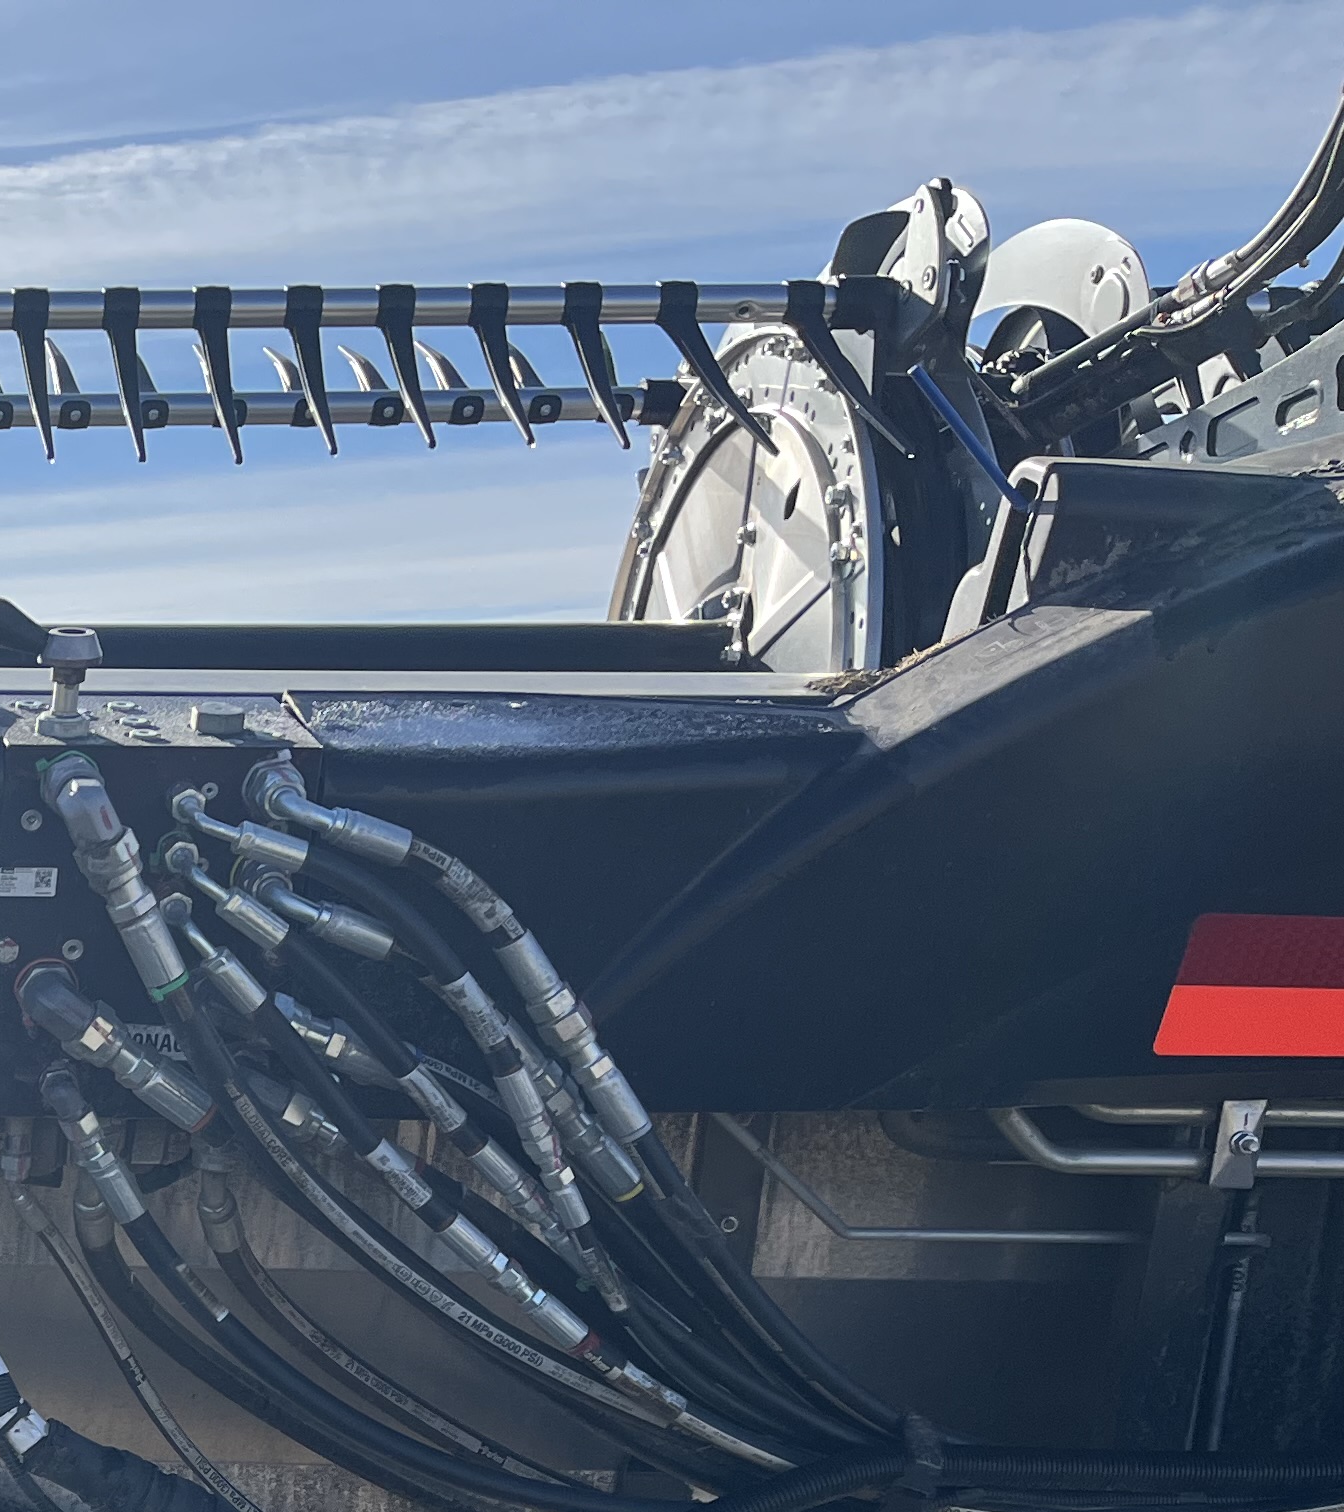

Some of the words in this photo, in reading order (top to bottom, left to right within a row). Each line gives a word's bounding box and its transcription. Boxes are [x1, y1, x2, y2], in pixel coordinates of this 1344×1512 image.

[457, 1310, 472, 1325] 21
[470, 1318, 495, 1339] MPa
[492, 1332, 522, 1355] (3000
[519, 1347, 544, 1368] PSI)
